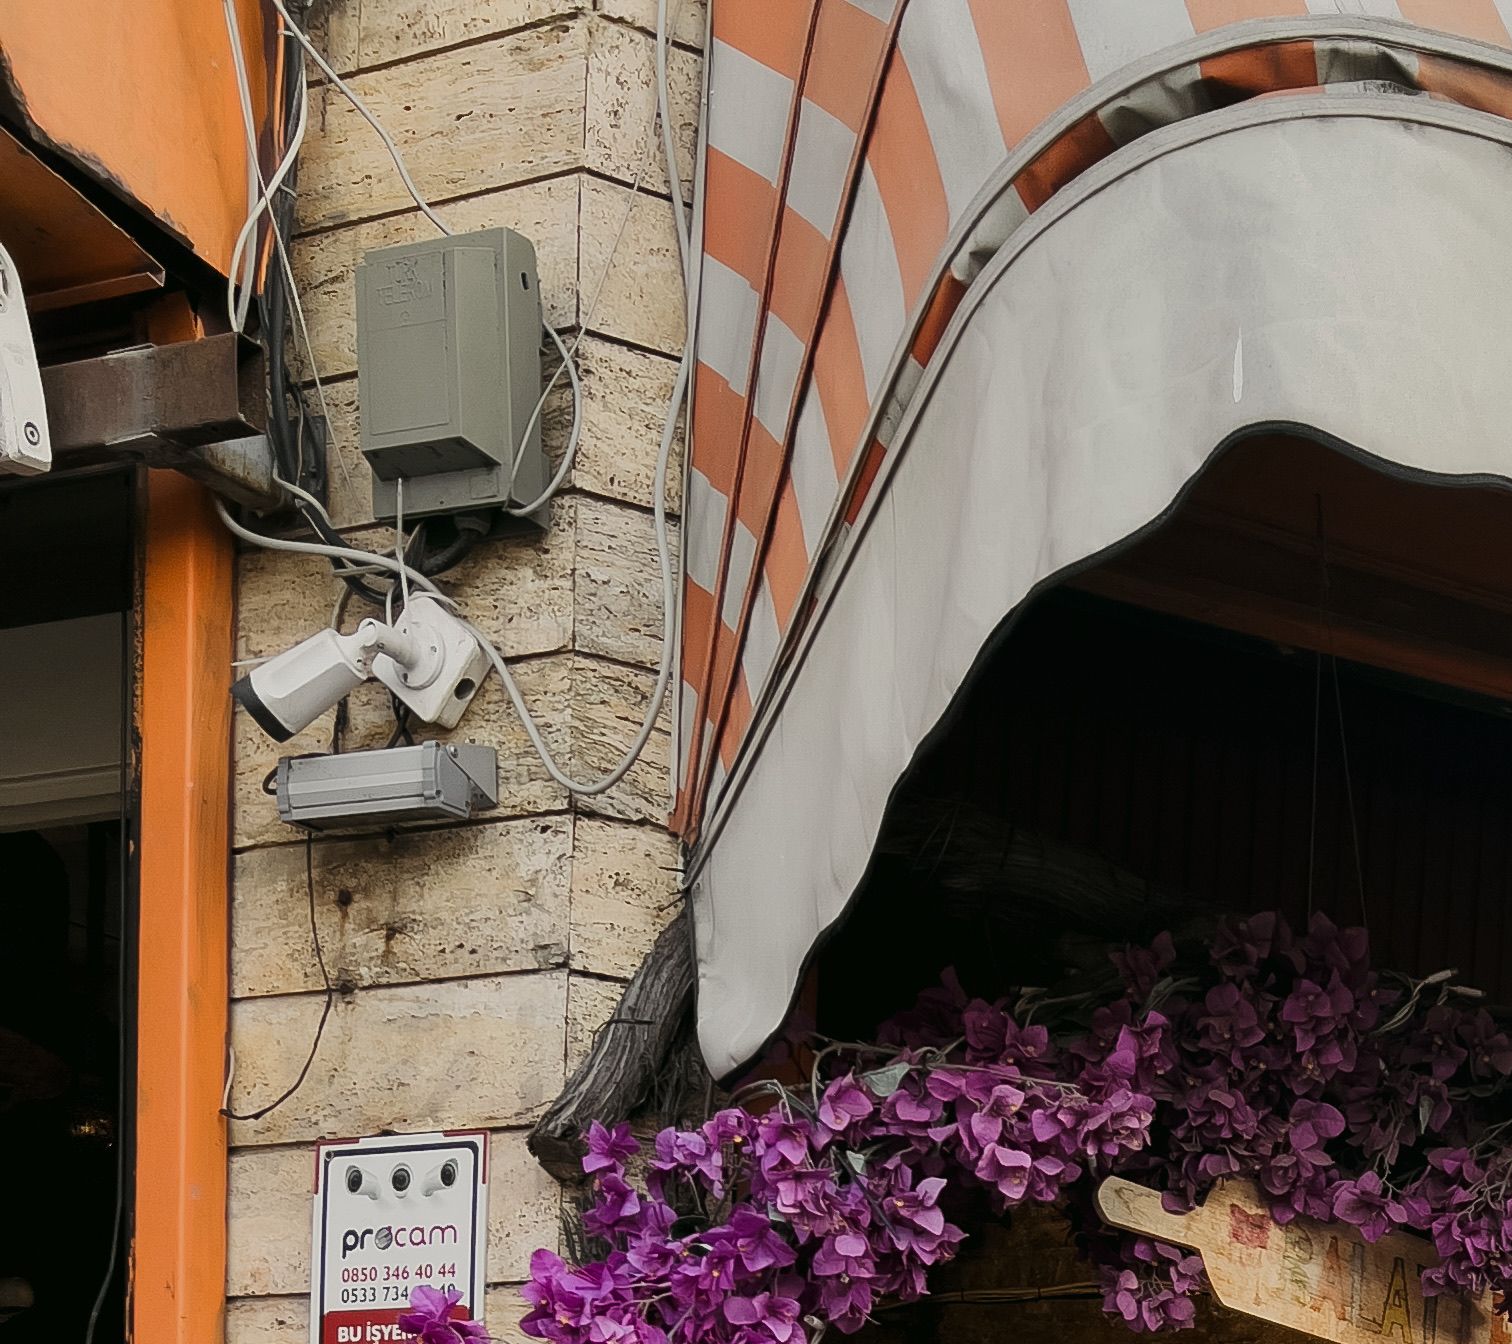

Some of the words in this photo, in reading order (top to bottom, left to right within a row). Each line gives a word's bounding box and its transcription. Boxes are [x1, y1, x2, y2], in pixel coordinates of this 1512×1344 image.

[341, 1225, 457, 1259] procam
[341, 1266, 377, 1283] 0850
[383, 1265, 410, 1281] 346
[415, 1263, 433, 1279] 40
[438, 1262, 456, 1278] 44
[341, 1287, 376, 1304] 0533
[383, 1285, 409, 1301] 734
[337, 1325, 362, 1342] BU
[366, 1321, 417, 1344] İŞYE
